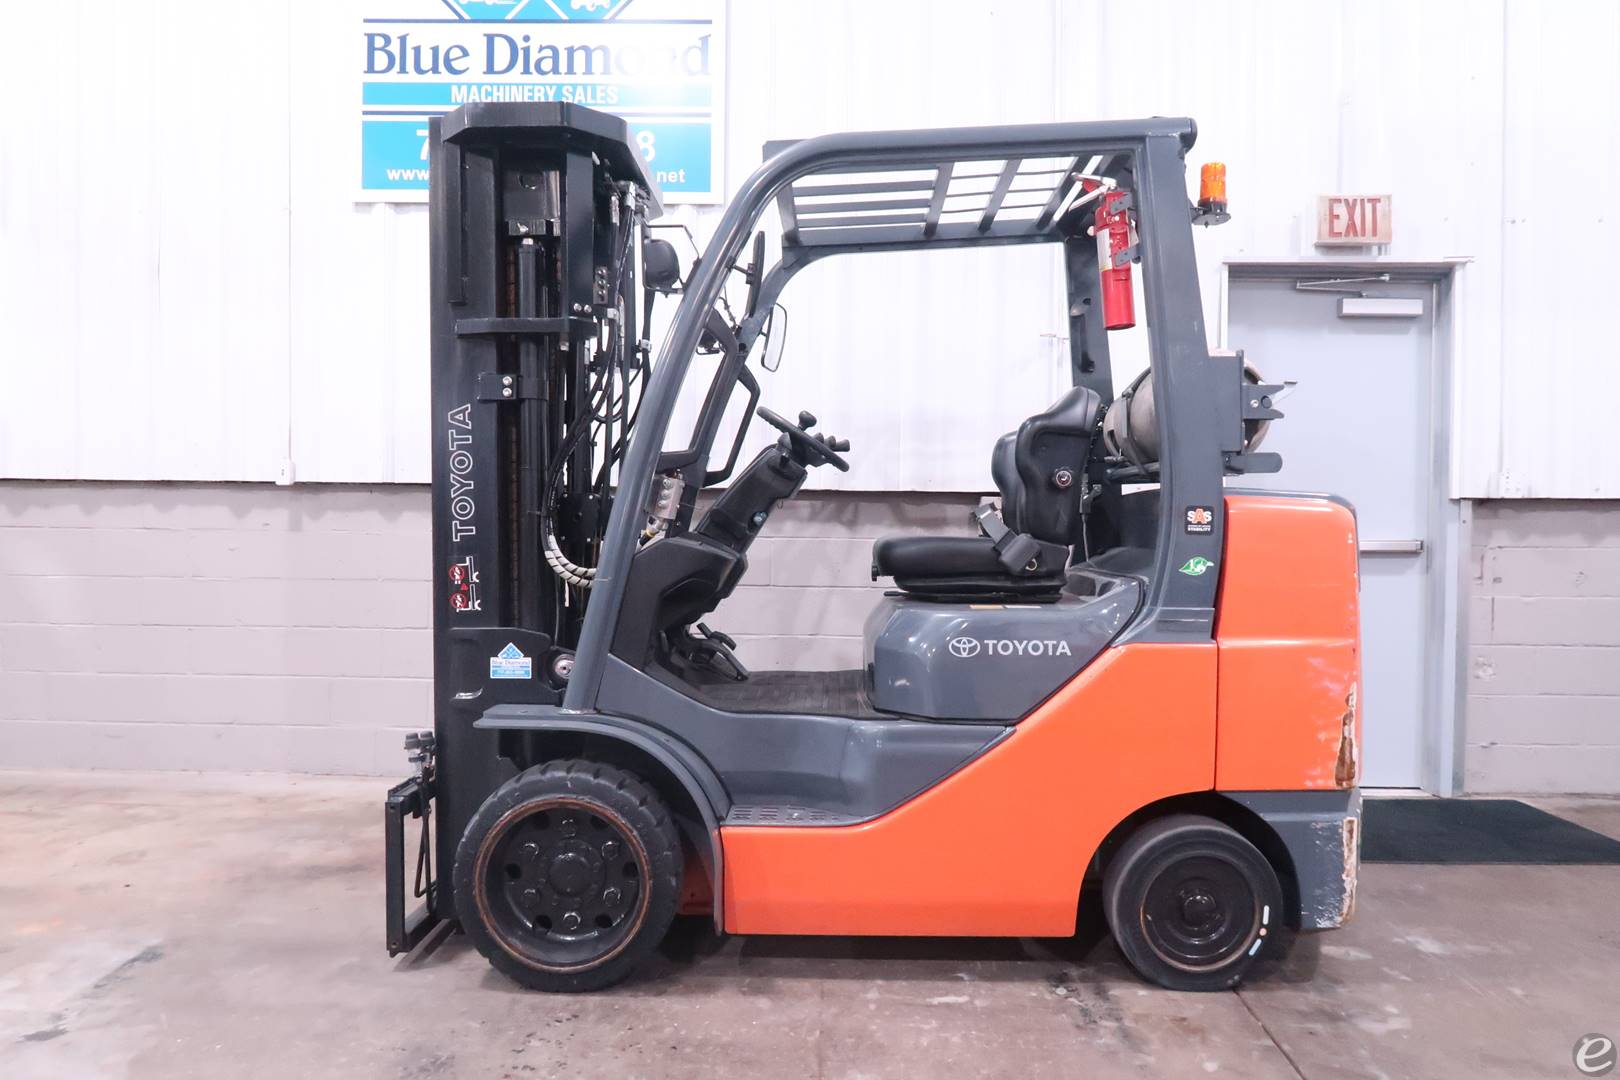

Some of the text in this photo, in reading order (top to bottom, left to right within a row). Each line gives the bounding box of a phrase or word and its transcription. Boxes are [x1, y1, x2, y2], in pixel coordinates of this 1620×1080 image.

[363, 32, 711, 76] Blue Diamod
[451, 84, 619, 104] MACHINERY SALES
[1327, 198, 1381, 238] EXIT
[447, 404, 476, 542] TOYOTA
[1187, 508, 1212, 524] SAS
[984, 639, 1072, 657] TOYOTA
